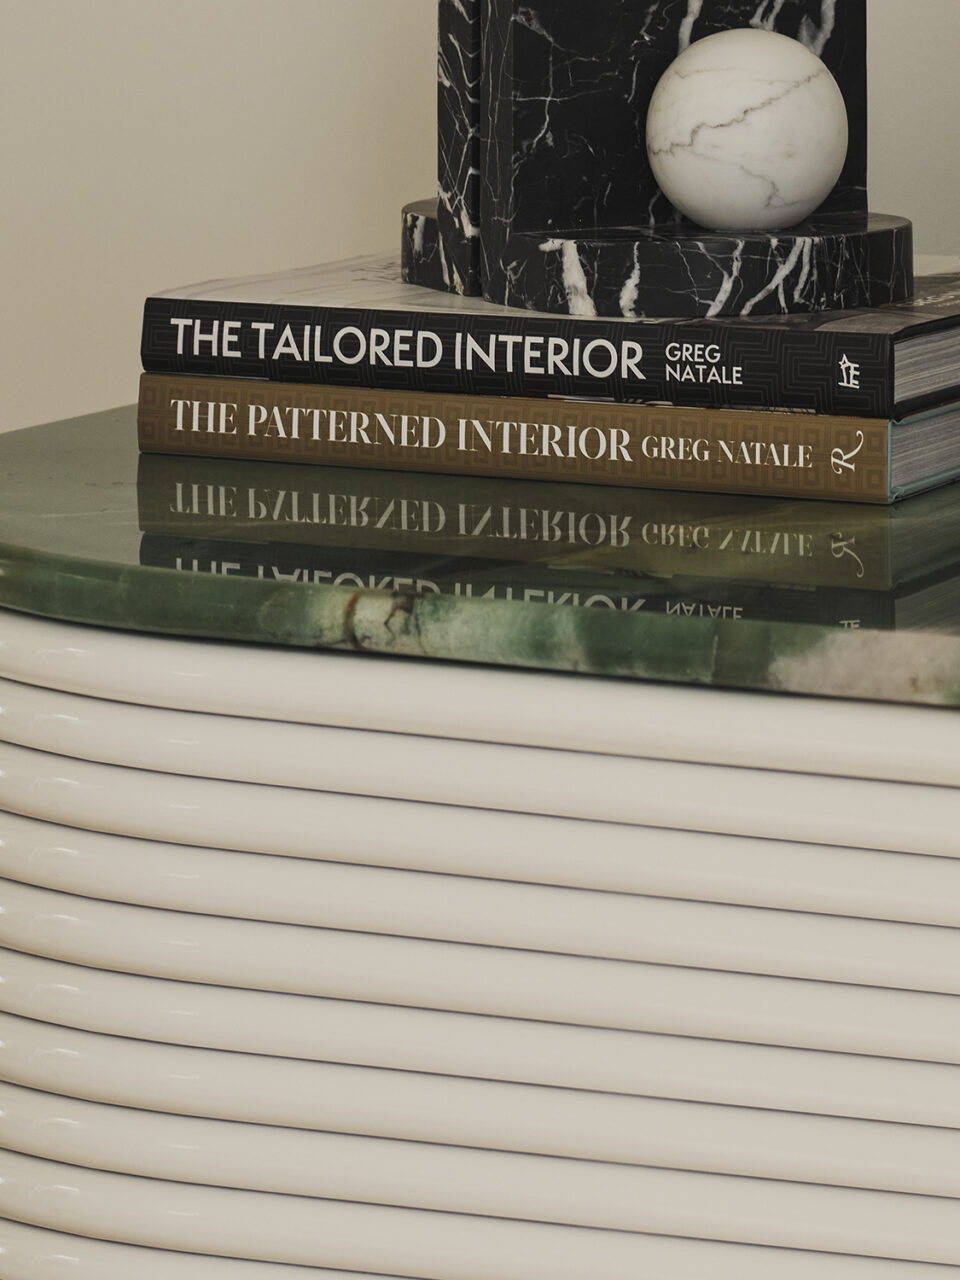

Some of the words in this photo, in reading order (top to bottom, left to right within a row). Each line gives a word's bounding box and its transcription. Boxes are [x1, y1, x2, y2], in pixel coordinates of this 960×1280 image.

[170, 318, 242, 358] THE
[251, 322, 443, 368] TAILORED
[455, 332, 646, 380] INTERIOR
[665, 342, 721, 362] GREG
[665, 364, 743, 385] NATALE
[170, 399, 237, 434] THE
[247, 404, 446, 449] PATTERNED
[457, 418, 633, 462] INTERIOR
[641, 435, 710, 462] GREG
[717, 439, 813, 468] NATALE
